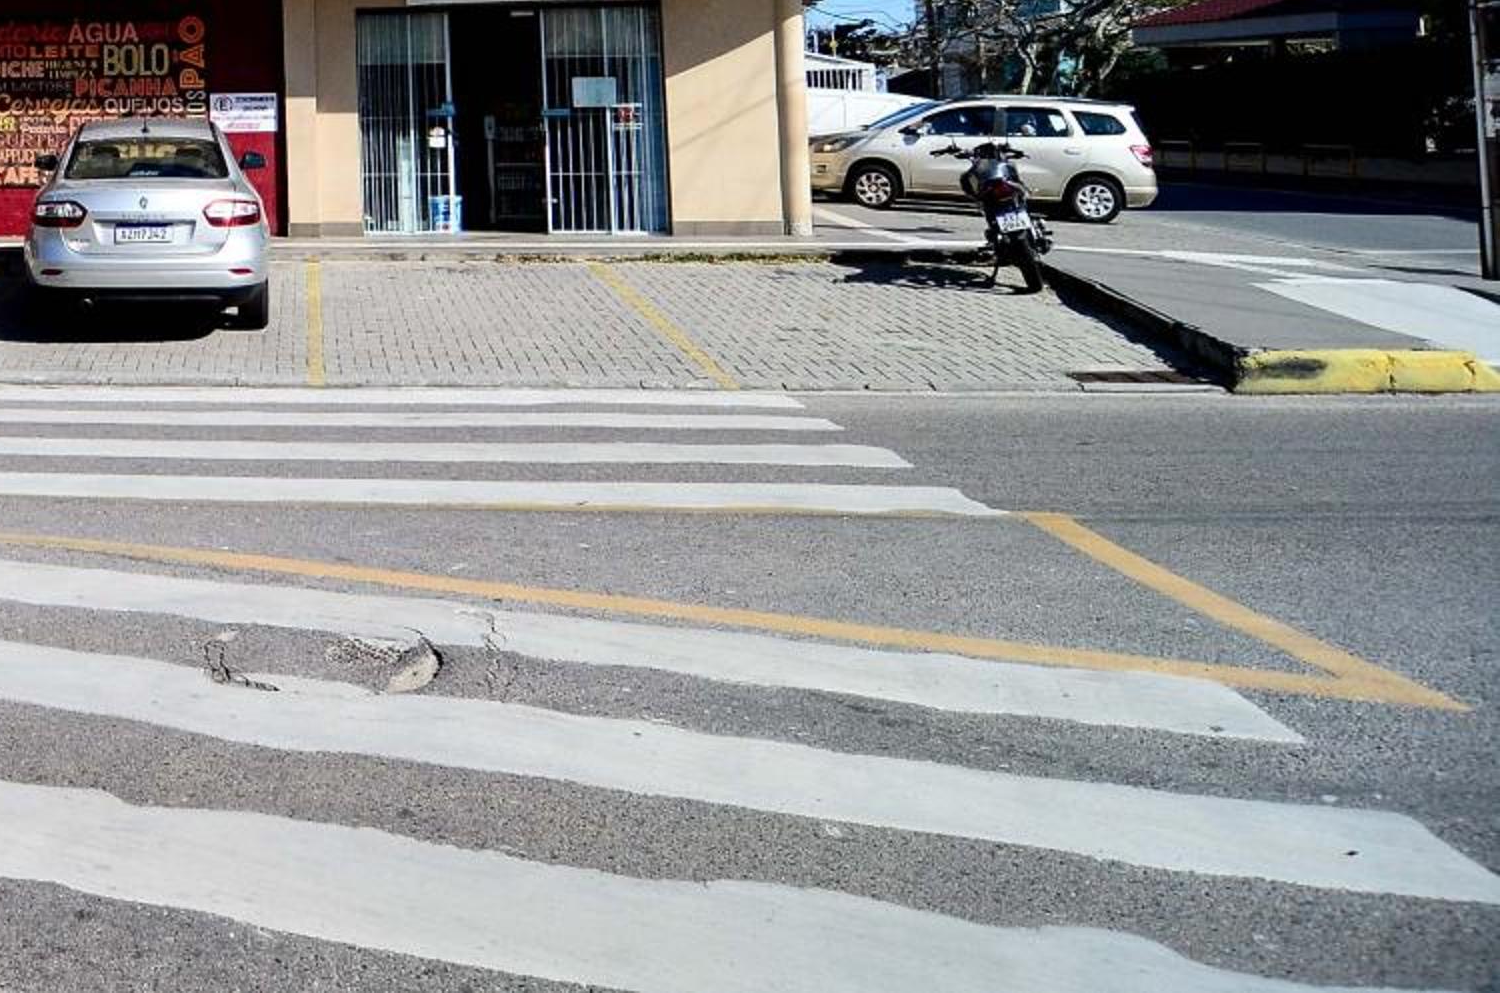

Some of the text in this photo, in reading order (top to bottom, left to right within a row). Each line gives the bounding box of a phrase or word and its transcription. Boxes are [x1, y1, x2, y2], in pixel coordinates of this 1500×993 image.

[30, 44, 100, 58] LEITE
[103, 43, 170, 76] BOLO
[75, 78, 177, 96] PICANHA
[104, 97, 184, 113] QUEIJOS
